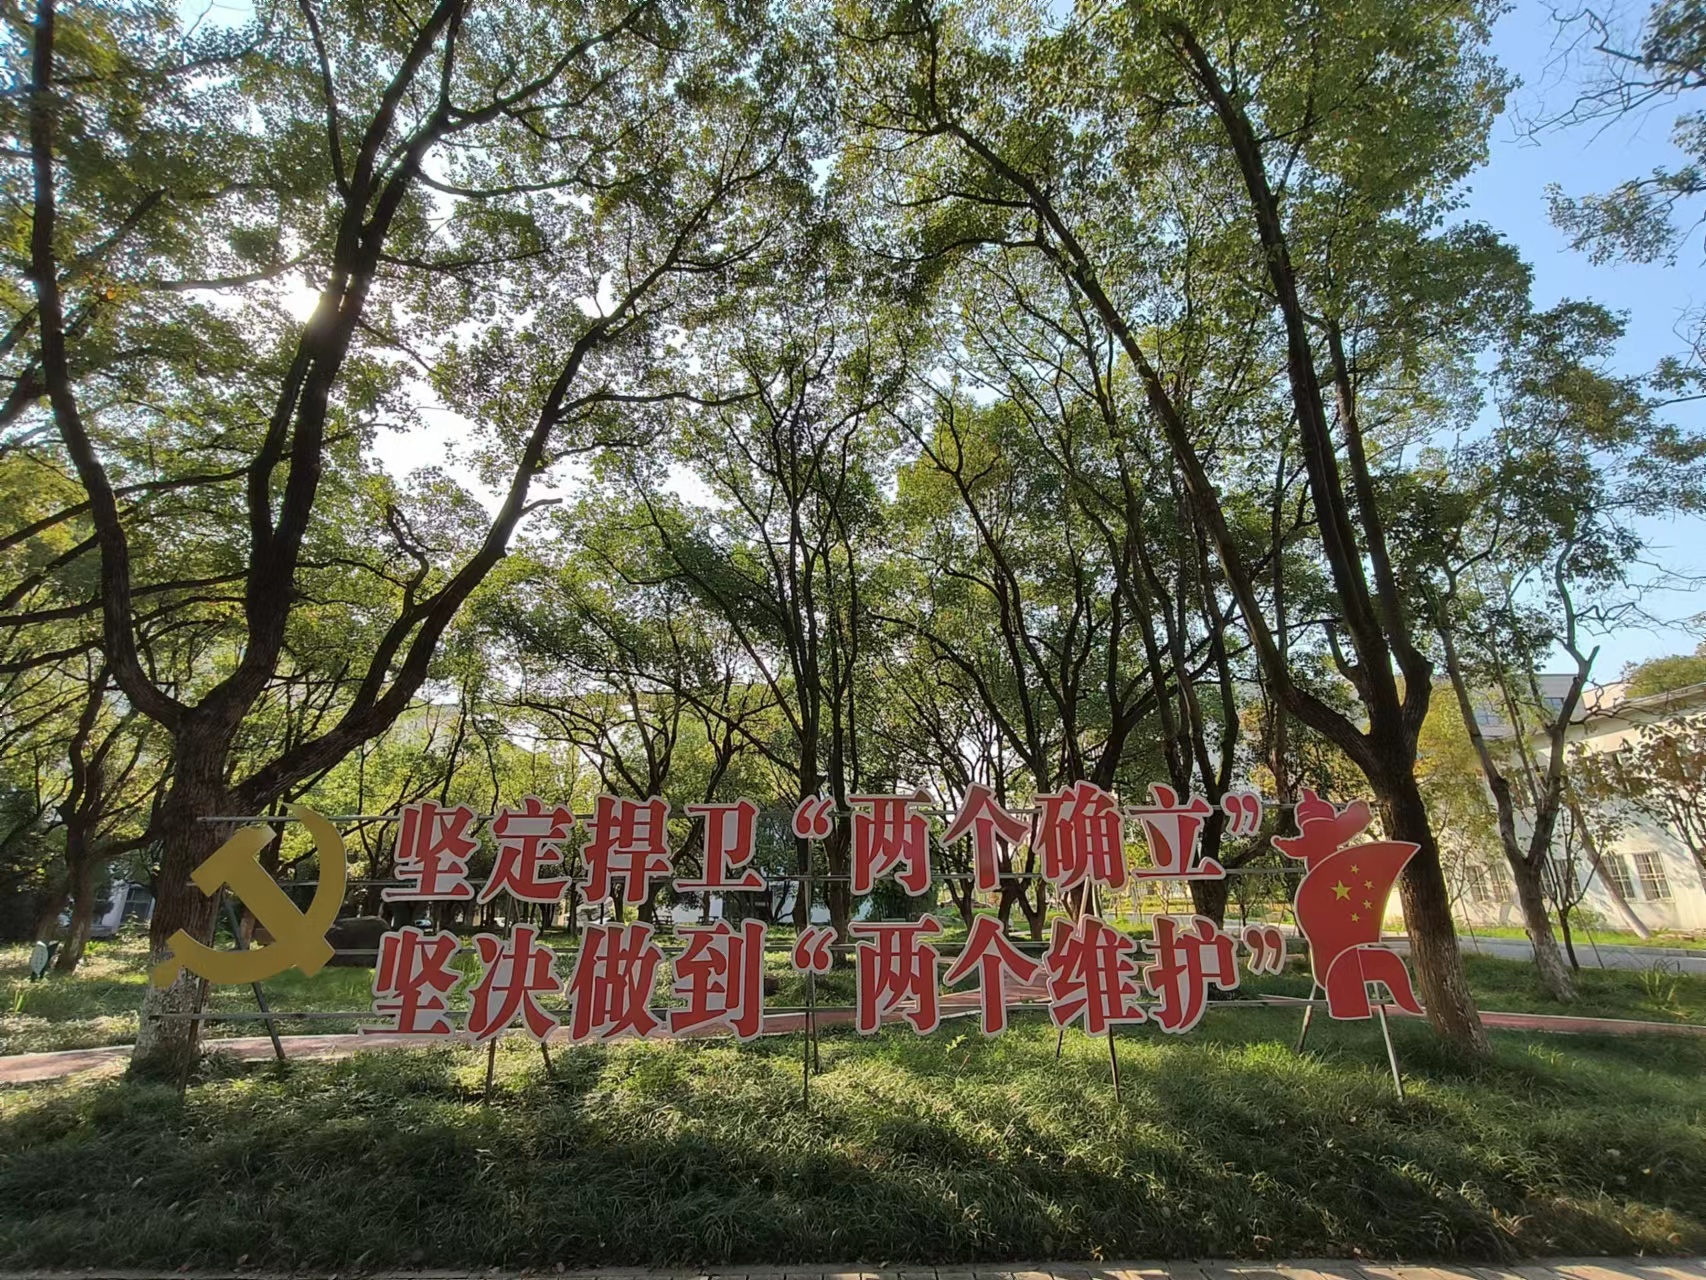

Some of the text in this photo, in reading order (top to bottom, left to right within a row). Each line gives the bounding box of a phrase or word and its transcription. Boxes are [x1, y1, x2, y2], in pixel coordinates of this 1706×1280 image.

[383, 781, 1261, 904] 坚定捍卫“两个确立”
[359, 914, 1285, 1041] 坚决做到“两个维护”
